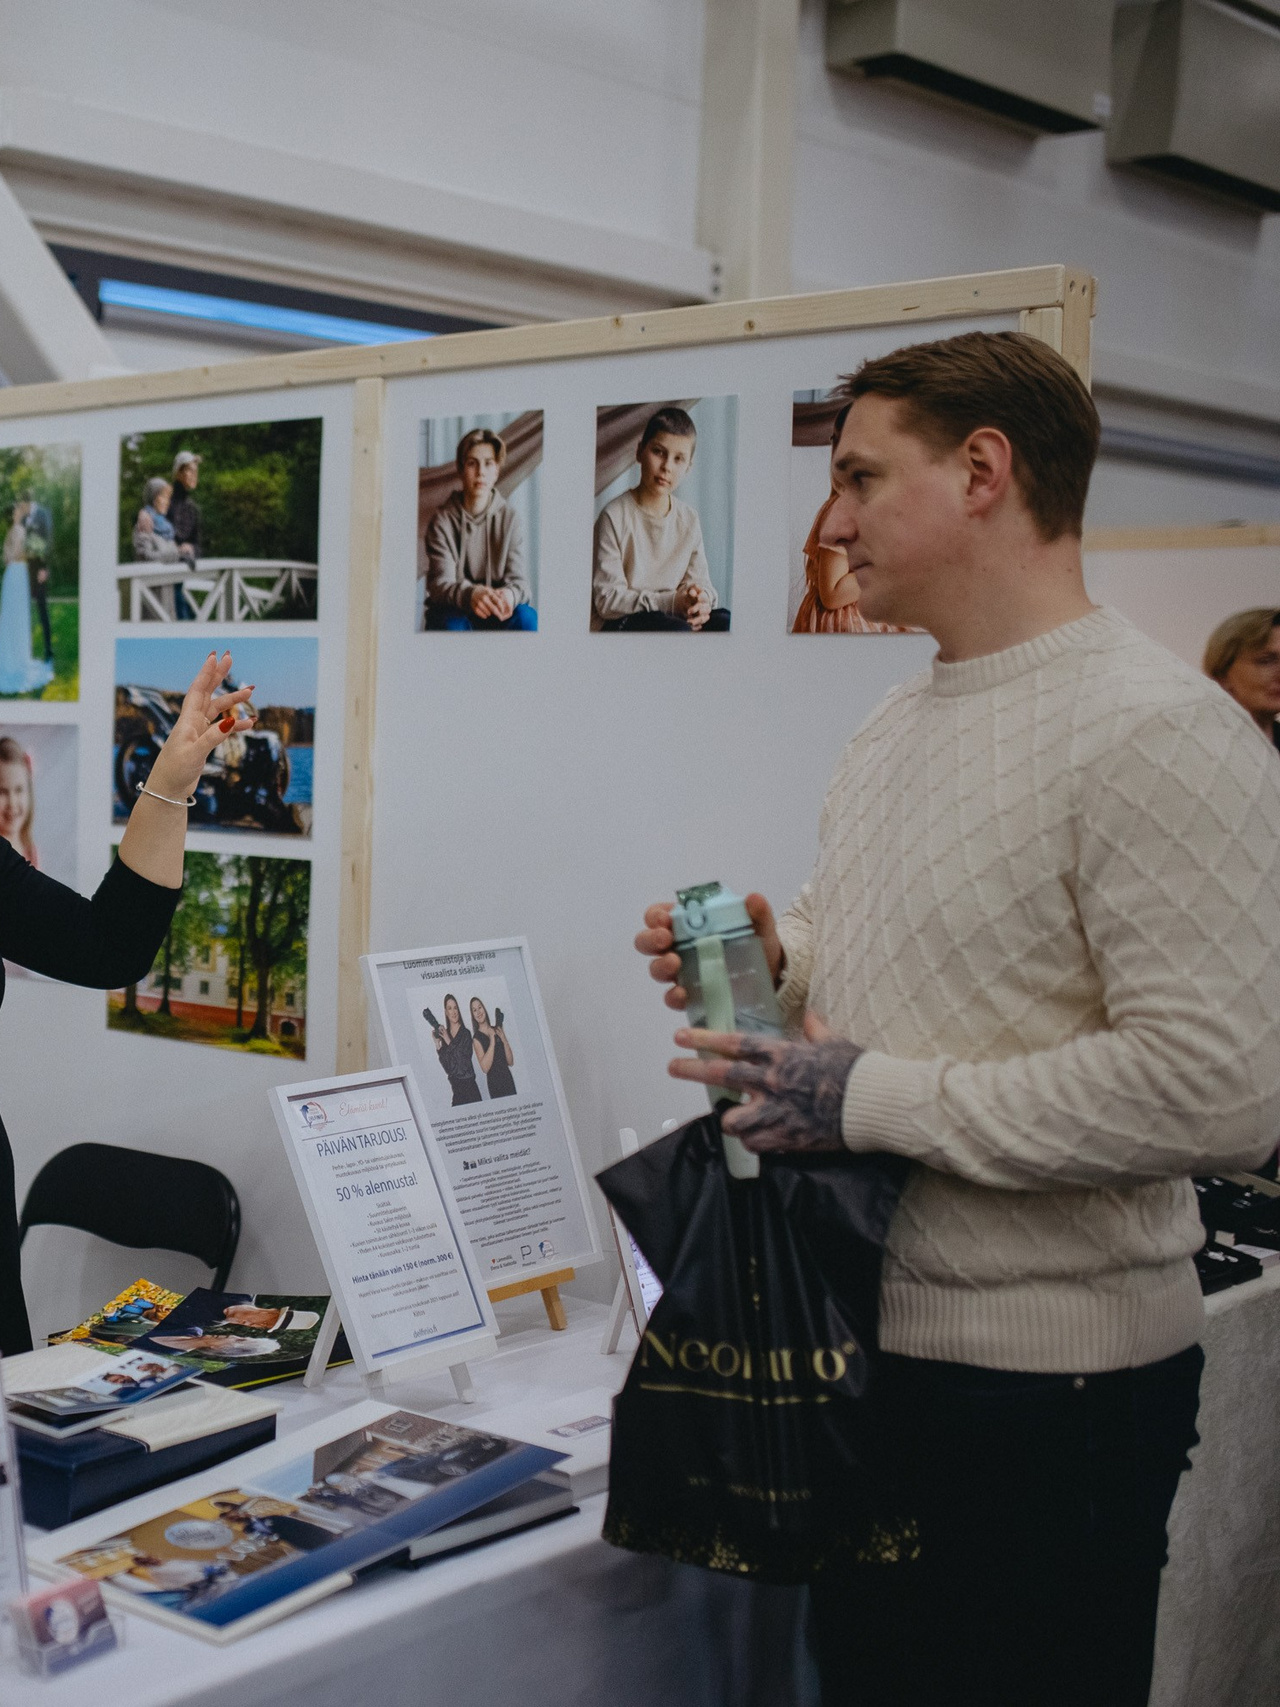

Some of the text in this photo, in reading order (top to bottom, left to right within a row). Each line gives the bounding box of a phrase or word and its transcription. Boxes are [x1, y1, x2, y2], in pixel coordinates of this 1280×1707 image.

[403, 958, 433, 969] Luomme
[464, 954, 472, 964] ja
[421, 964, 485, 979] visuaalista sisältöä!
[316, 1128, 407, 1156] PÄIVÄN TARJOUS!
[493, 1154, 509, 1162] valita
[336, 1172, 417, 1202] 50 % alennusta!
[352, 1275, 369, 1284] Hinta
[369, 1270, 389, 1280] tänään
[390, 1266, 403, 1274] vain
[402, 1262, 414, 1270] 150
[418, 1258, 437, 1267] (norm.
[437, 1254, 448, 1262] 300
[413, 1324, 438, 1338] delfinio.fi
